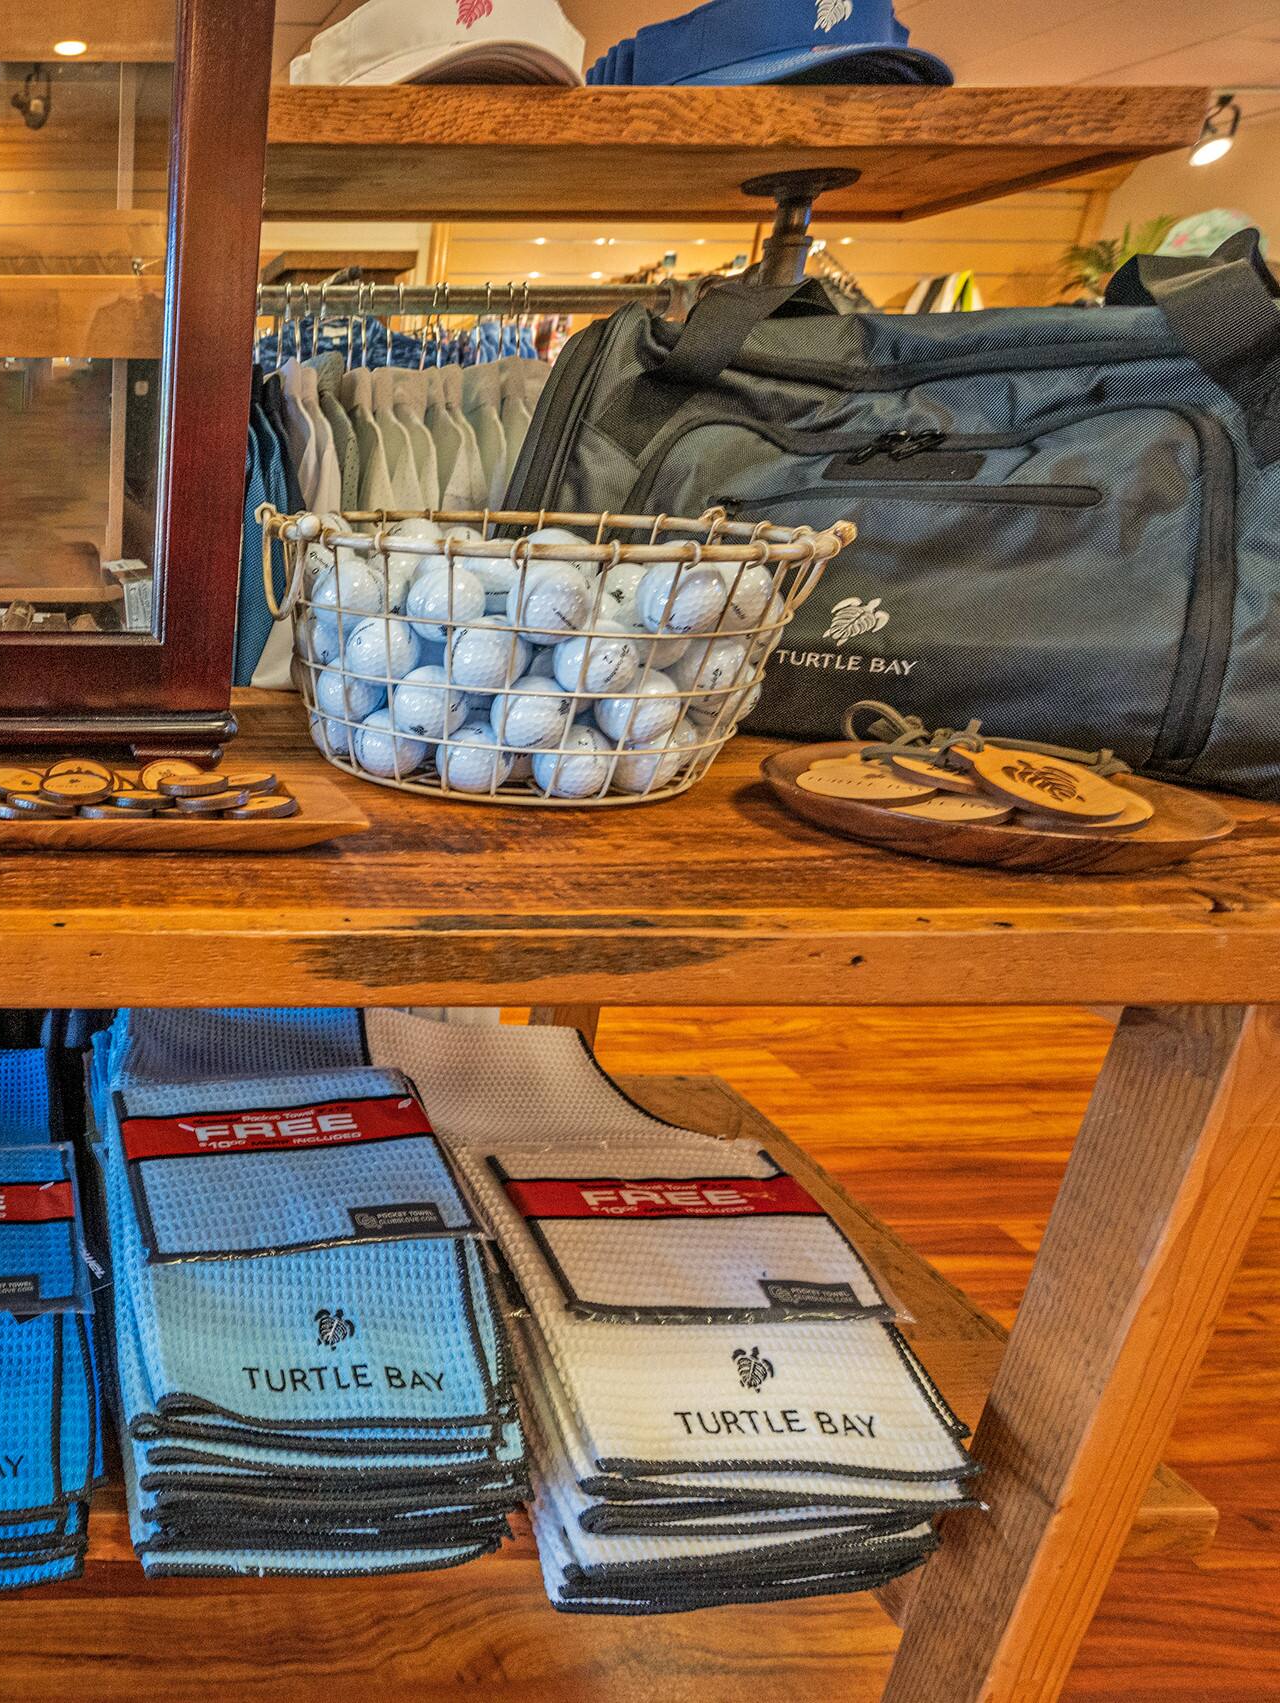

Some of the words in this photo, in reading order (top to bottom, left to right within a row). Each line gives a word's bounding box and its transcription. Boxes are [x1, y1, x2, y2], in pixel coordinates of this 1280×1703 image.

[776, 650, 864, 671] TURTLE
[870, 657, 919, 676] BAY
[195, 1113, 358, 1142] FREE
[293, 1132, 362, 1144] INCLUDED
[580, 1190, 748, 1206] FREE
[241, 1364, 373, 1392] TURTLE
[384, 1366, 444, 1392] BAY
[674, 1409, 807, 1435] TURTLE
[814, 1411, 876, 1438] BAY
